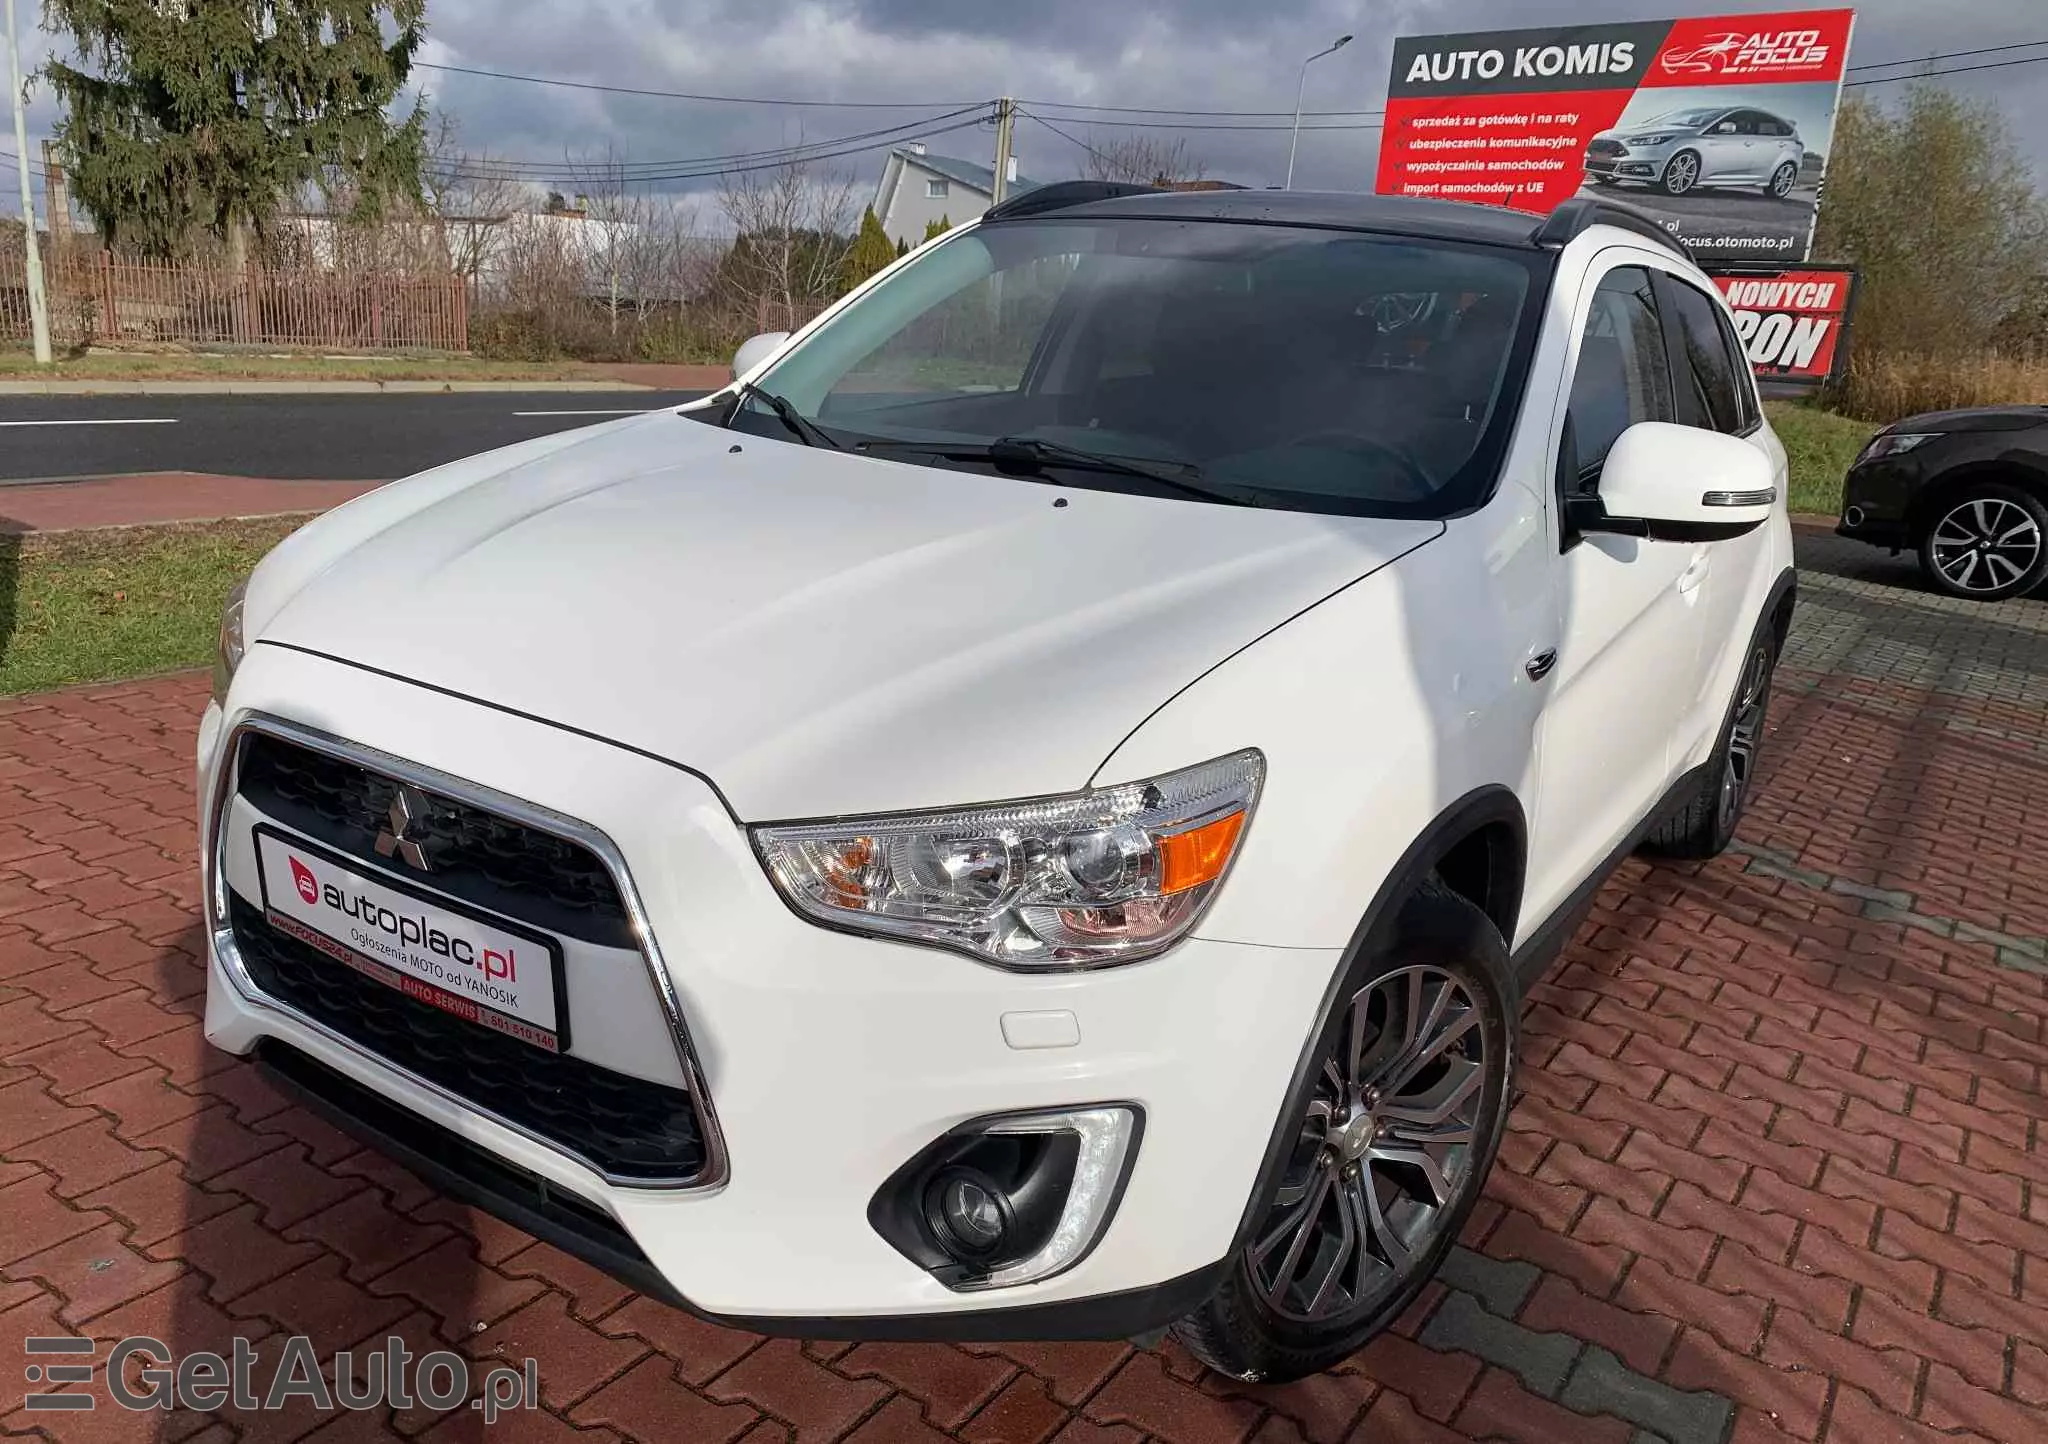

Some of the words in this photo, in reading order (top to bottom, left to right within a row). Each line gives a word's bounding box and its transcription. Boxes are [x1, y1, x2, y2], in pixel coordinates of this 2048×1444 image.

[1742, 30, 1820, 49] AUTO
[1406, 49, 1505, 83] AUTO
[1513, 42, 1636, 77] KOMIS
[1734, 46, 1829, 65] FOCUS
[1412, 115, 1461, 128] sprzedaż
[1463, 117, 1476, 126] za
[1478, 114, 1528, 128] gotówkę
[1537, 114, 1552, 124] na
[1554, 112, 1579, 126] raty
[1409, 136, 1487, 150] ubezpieczenia
[1489, 135, 1577, 150] komunikacyjne
[1406, 159, 1485, 173] wypożyczalnia
[1487, 158, 1565, 171] samochodów
[1403, 182, 1439, 196] import
[1441, 182, 1515, 193] samochodów
[1516, 184, 1523, 193] z
[1526, 182, 1544, 193] UE
[1678, 231, 1794, 250] ocus.otomoto.pl
[1725, 281, 1836, 309] NOWYCH
[323, 883, 516, 983] autoplac.pl
[351, 928, 407, 964] Ogłoszenia
[410, 952, 444, 978] MOTO
[447, 973, 462, 986] od
[465, 975, 520, 1009] YANOSIK
[404, 979, 432, 1001] AUTO
[435, 992, 476, 1019] SERWIS
[512, 1024, 532, 1040] 510
[535, 1033, 554, 1048] 140
